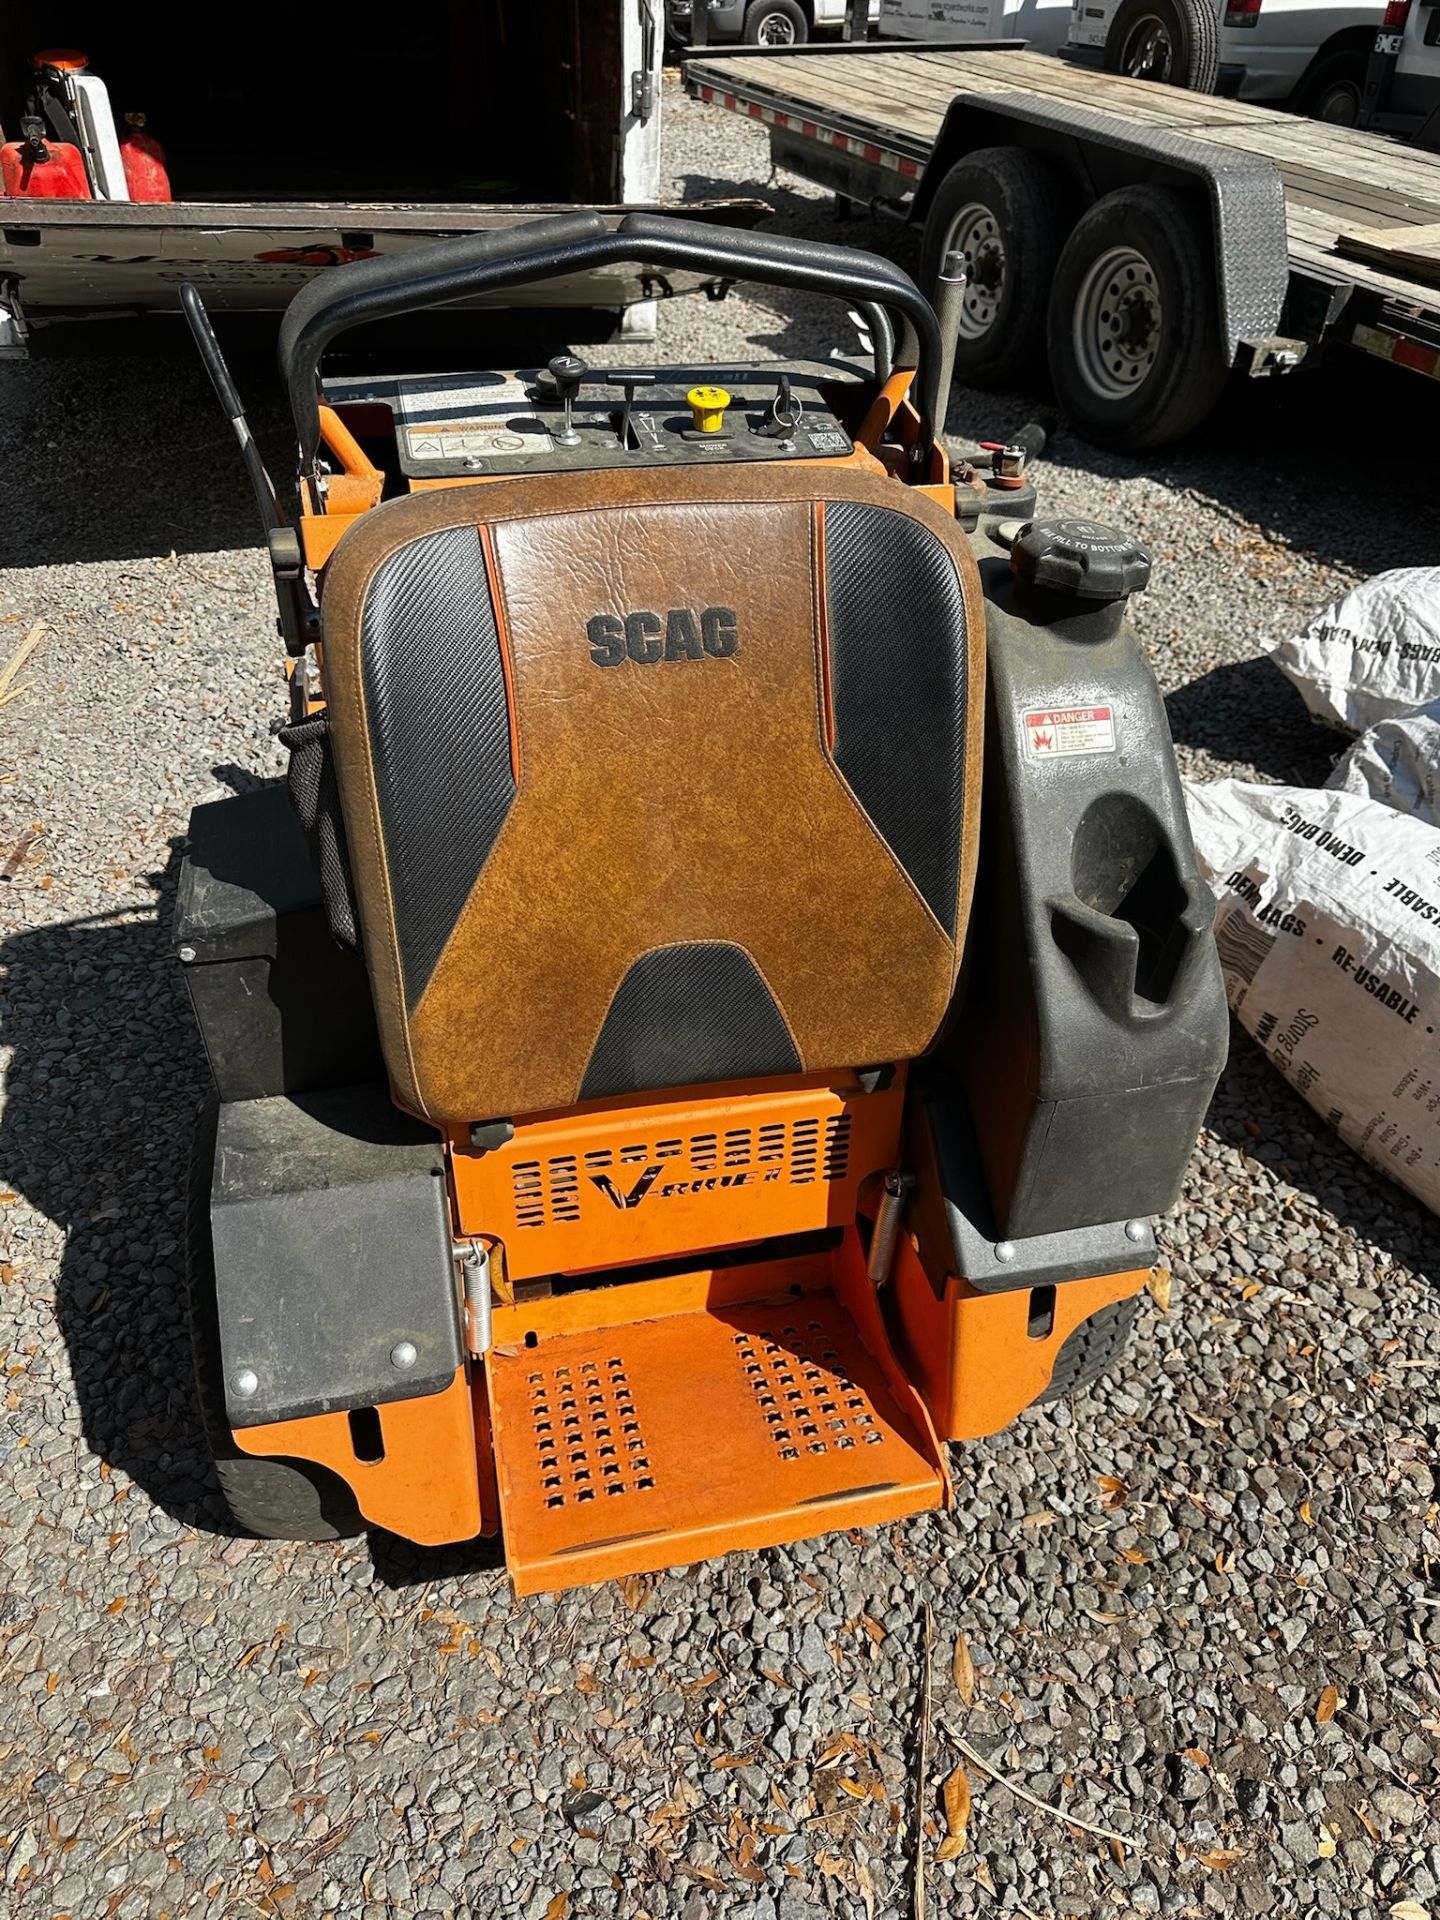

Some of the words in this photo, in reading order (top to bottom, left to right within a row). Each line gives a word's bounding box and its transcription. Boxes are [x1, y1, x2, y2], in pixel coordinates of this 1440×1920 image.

[1074, 541, 1088, 550] TO
[586, 607, 739, 668] SCAG
[1053, 710, 1096, 724] DANGER
[1315, 829, 1366, 868] DEMO
[1331, 944, 1421, 1025] RE-USABLE
[1276, 1007, 1320, 1057] Strong
